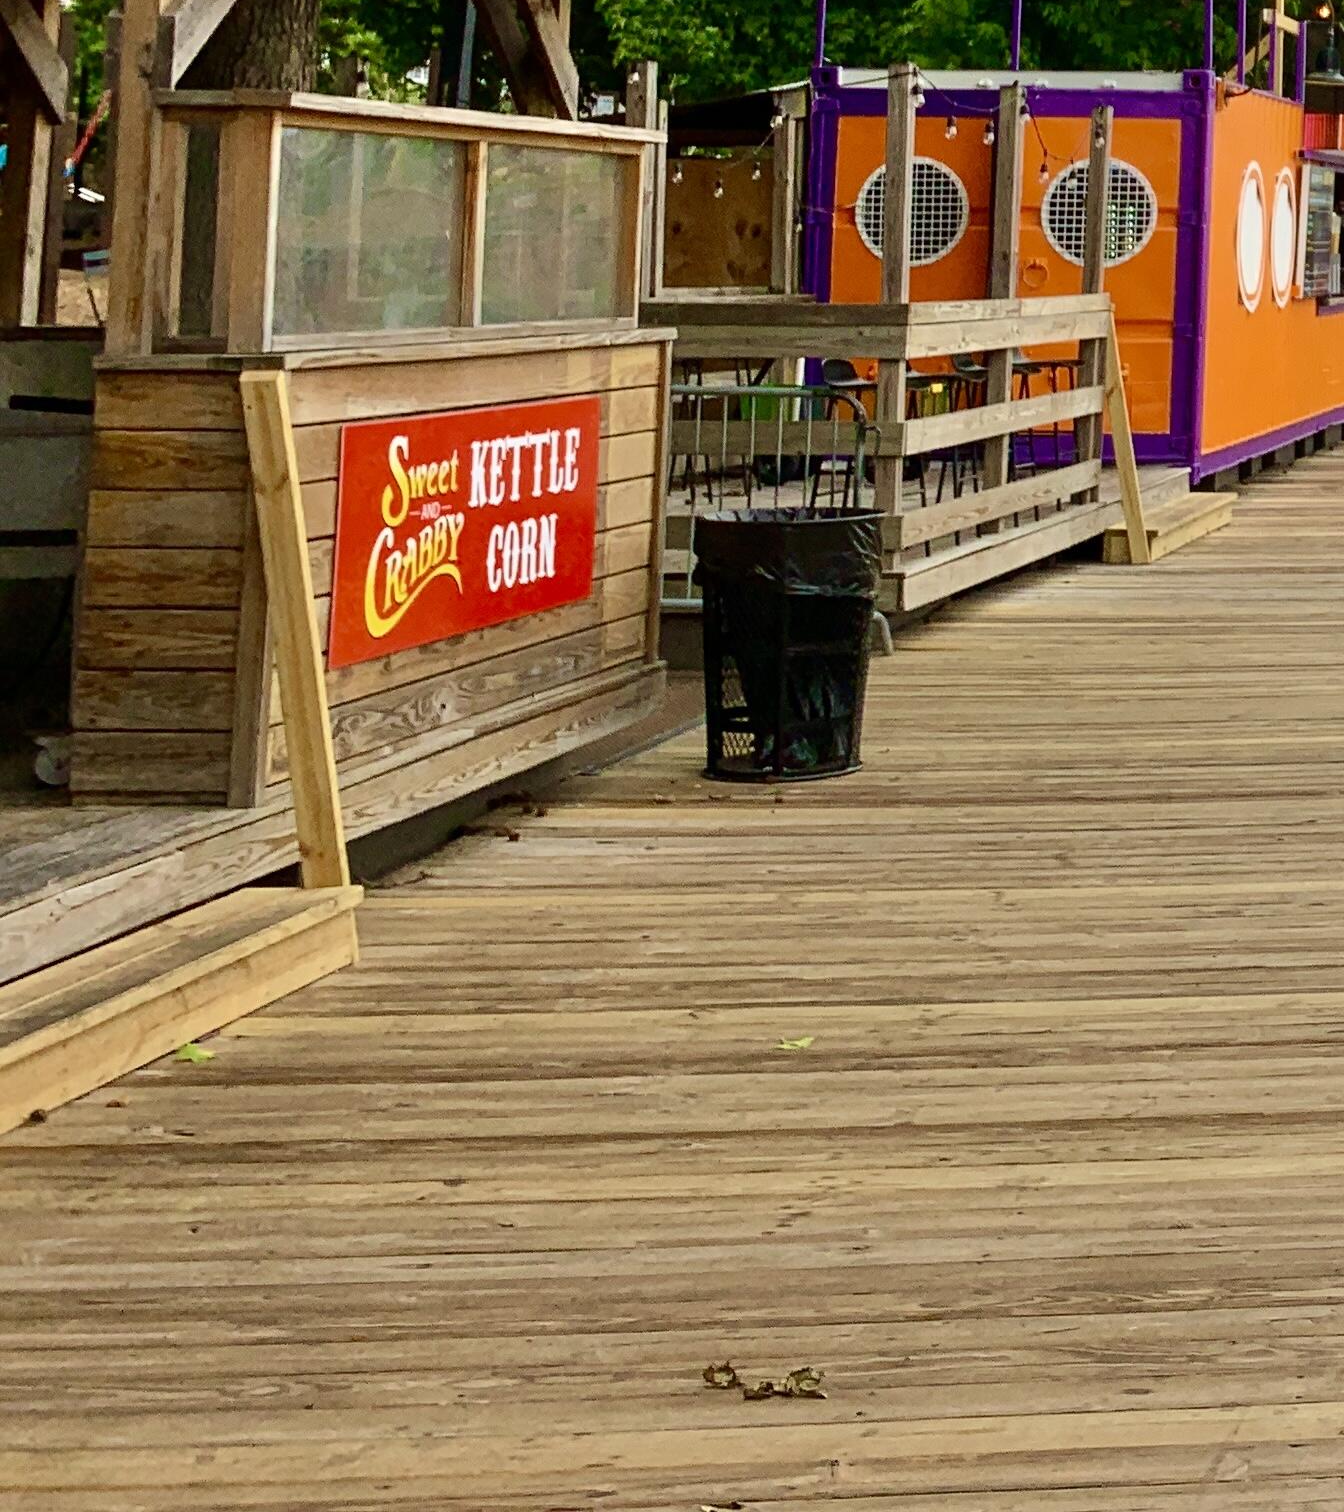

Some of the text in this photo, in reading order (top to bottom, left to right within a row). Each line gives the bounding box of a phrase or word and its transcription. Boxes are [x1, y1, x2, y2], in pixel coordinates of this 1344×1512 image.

[381, 435, 460, 527] Sweet
[467, 427, 581, 508] KETTLE
[420, 501, 441, 521] AND
[365, 512, 465, 638] CRABBY
[486, 513, 559, 593] CORN
